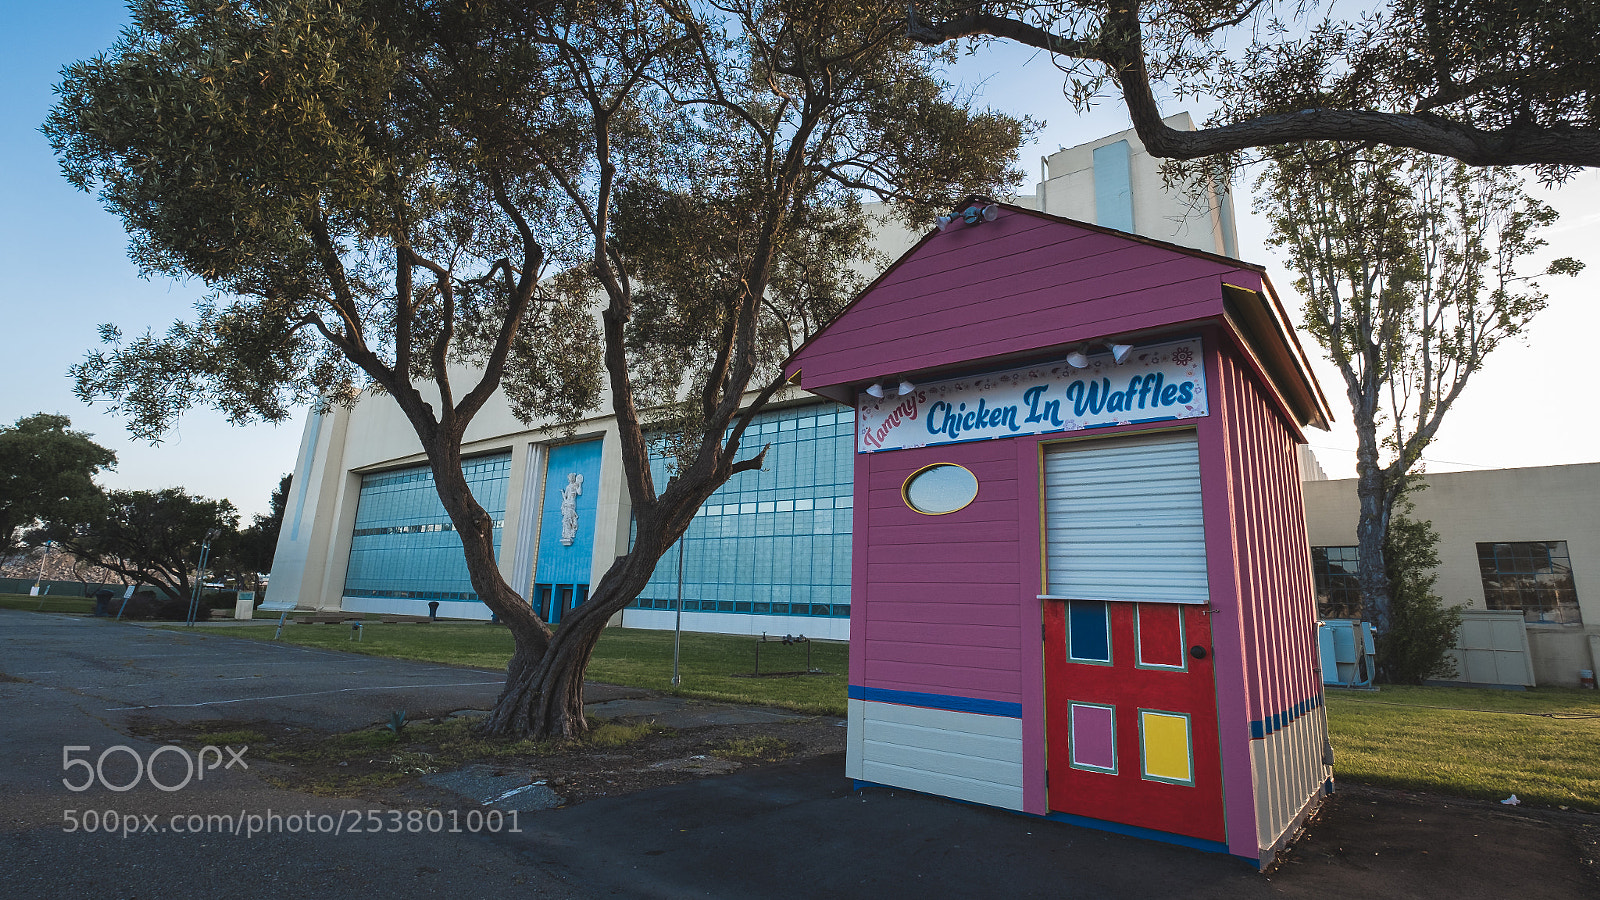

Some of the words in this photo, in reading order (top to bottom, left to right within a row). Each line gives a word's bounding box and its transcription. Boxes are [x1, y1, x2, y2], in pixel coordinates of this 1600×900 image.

[864, 390, 927, 448] Tammy's
[926, 399, 1021, 438] Chicken
[1023, 384, 1064, 424] In
[1065, 371, 1194, 416] Waffles
